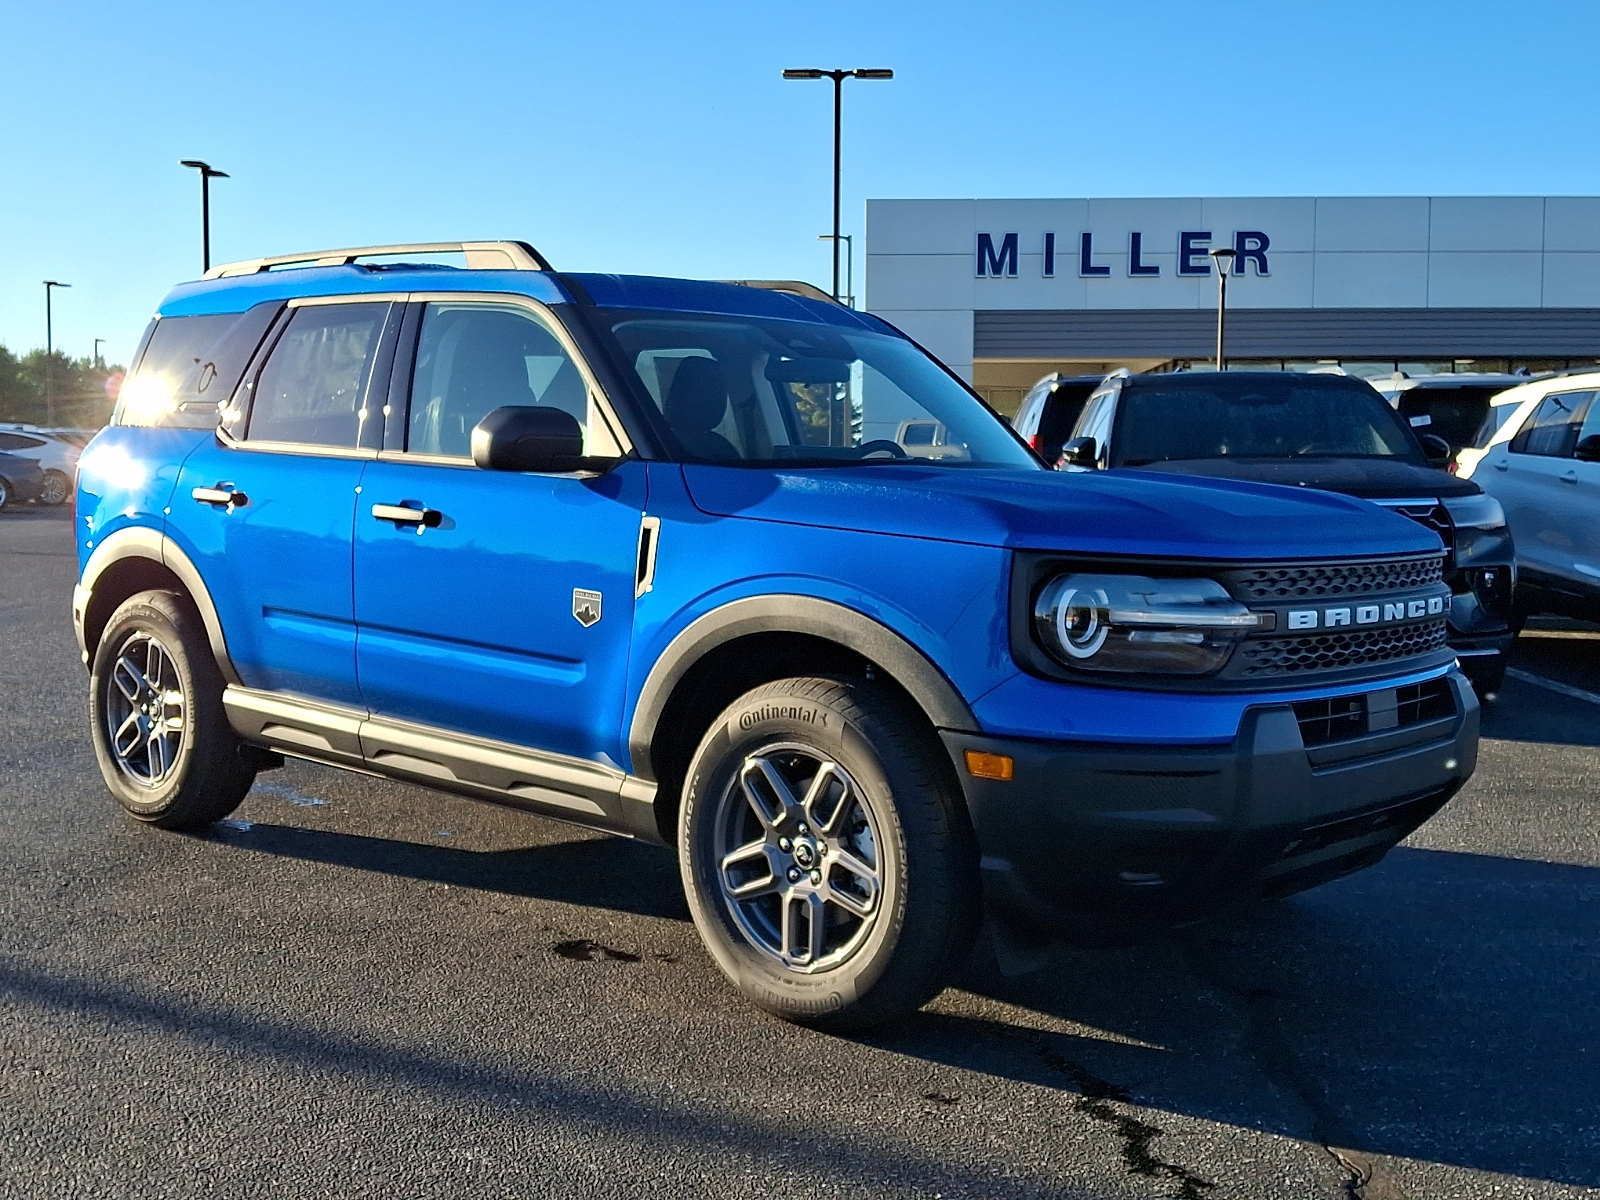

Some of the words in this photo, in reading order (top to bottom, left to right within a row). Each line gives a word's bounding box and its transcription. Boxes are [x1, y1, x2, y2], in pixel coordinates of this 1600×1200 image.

[975, 231, 1271, 278] MILLER
[1287, 597, 1443, 630] BRONCO
[739, 703, 818, 731] Continental
